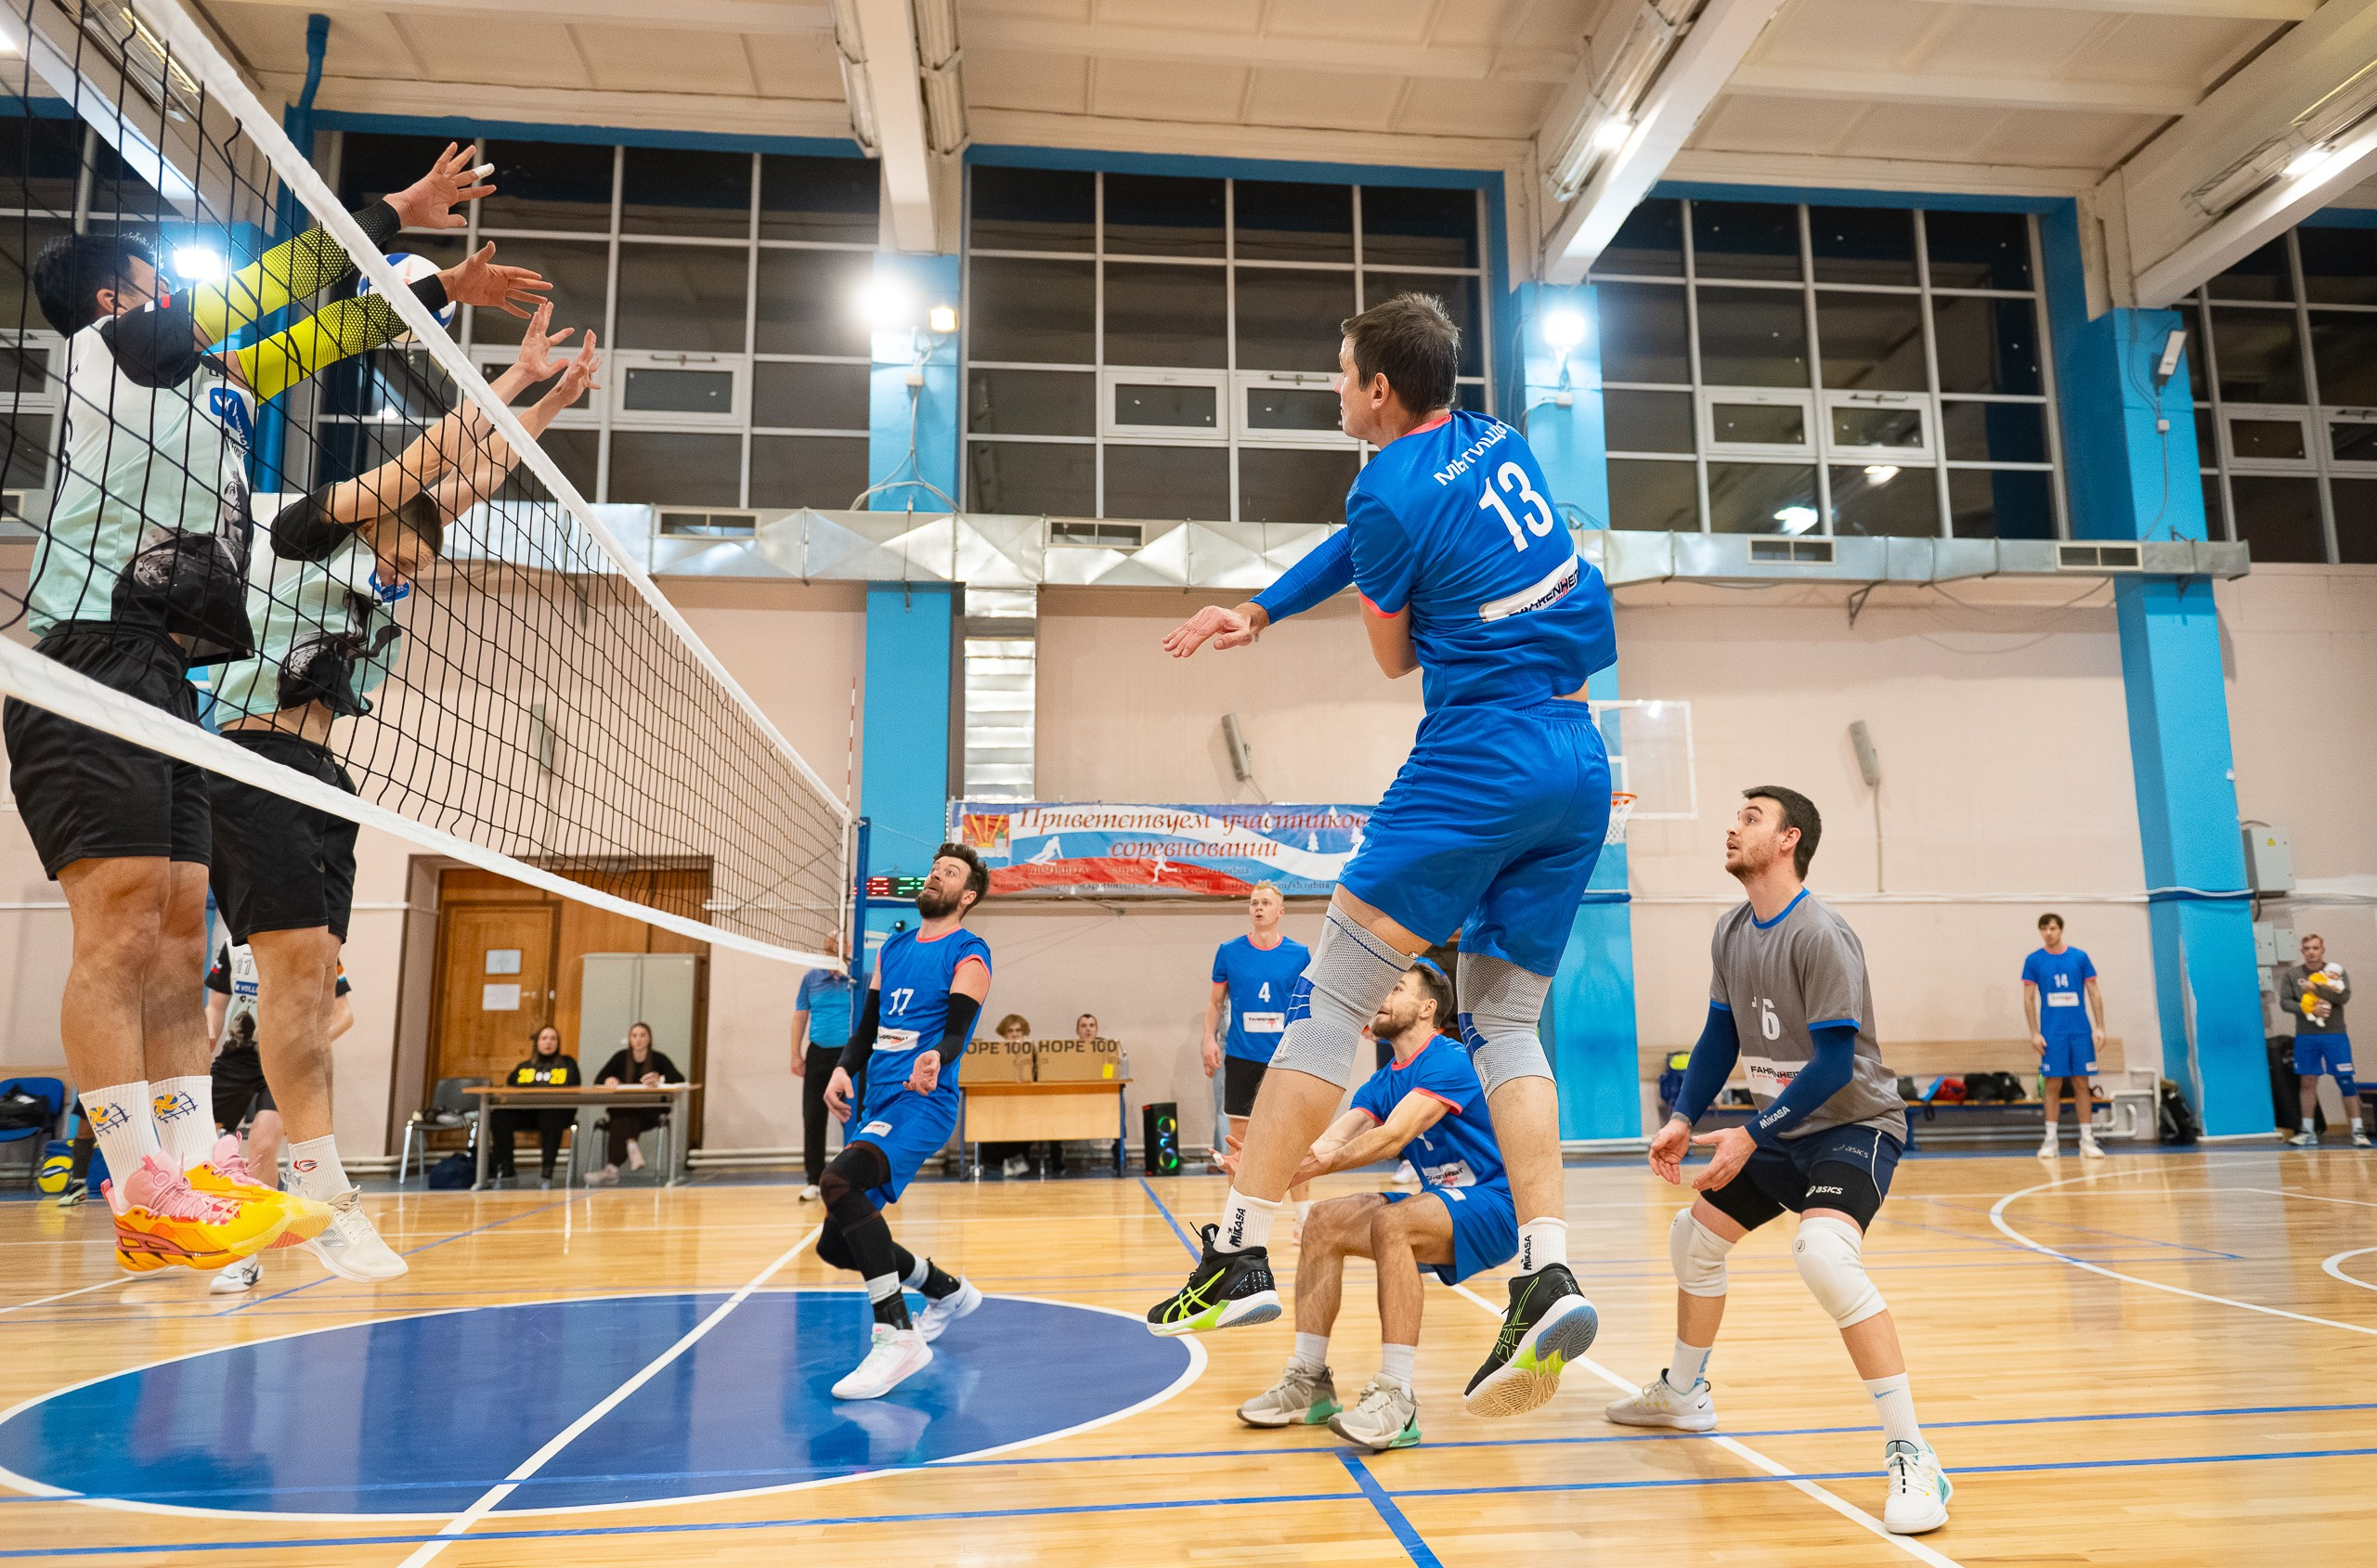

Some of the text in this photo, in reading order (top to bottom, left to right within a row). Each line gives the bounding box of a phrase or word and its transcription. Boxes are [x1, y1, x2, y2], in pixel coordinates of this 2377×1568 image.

[1478, 461, 1553, 552] 13
[1019, 807, 1368, 836] Приветствуем участников
[1258, 981, 1271, 1003] 4
[2054, 974, 2069, 989] 14
[888, 988, 915, 1016] 17
[966, 1041, 1033, 1055] OPE 100
[1038, 1040, 1085, 1054] HOPE
